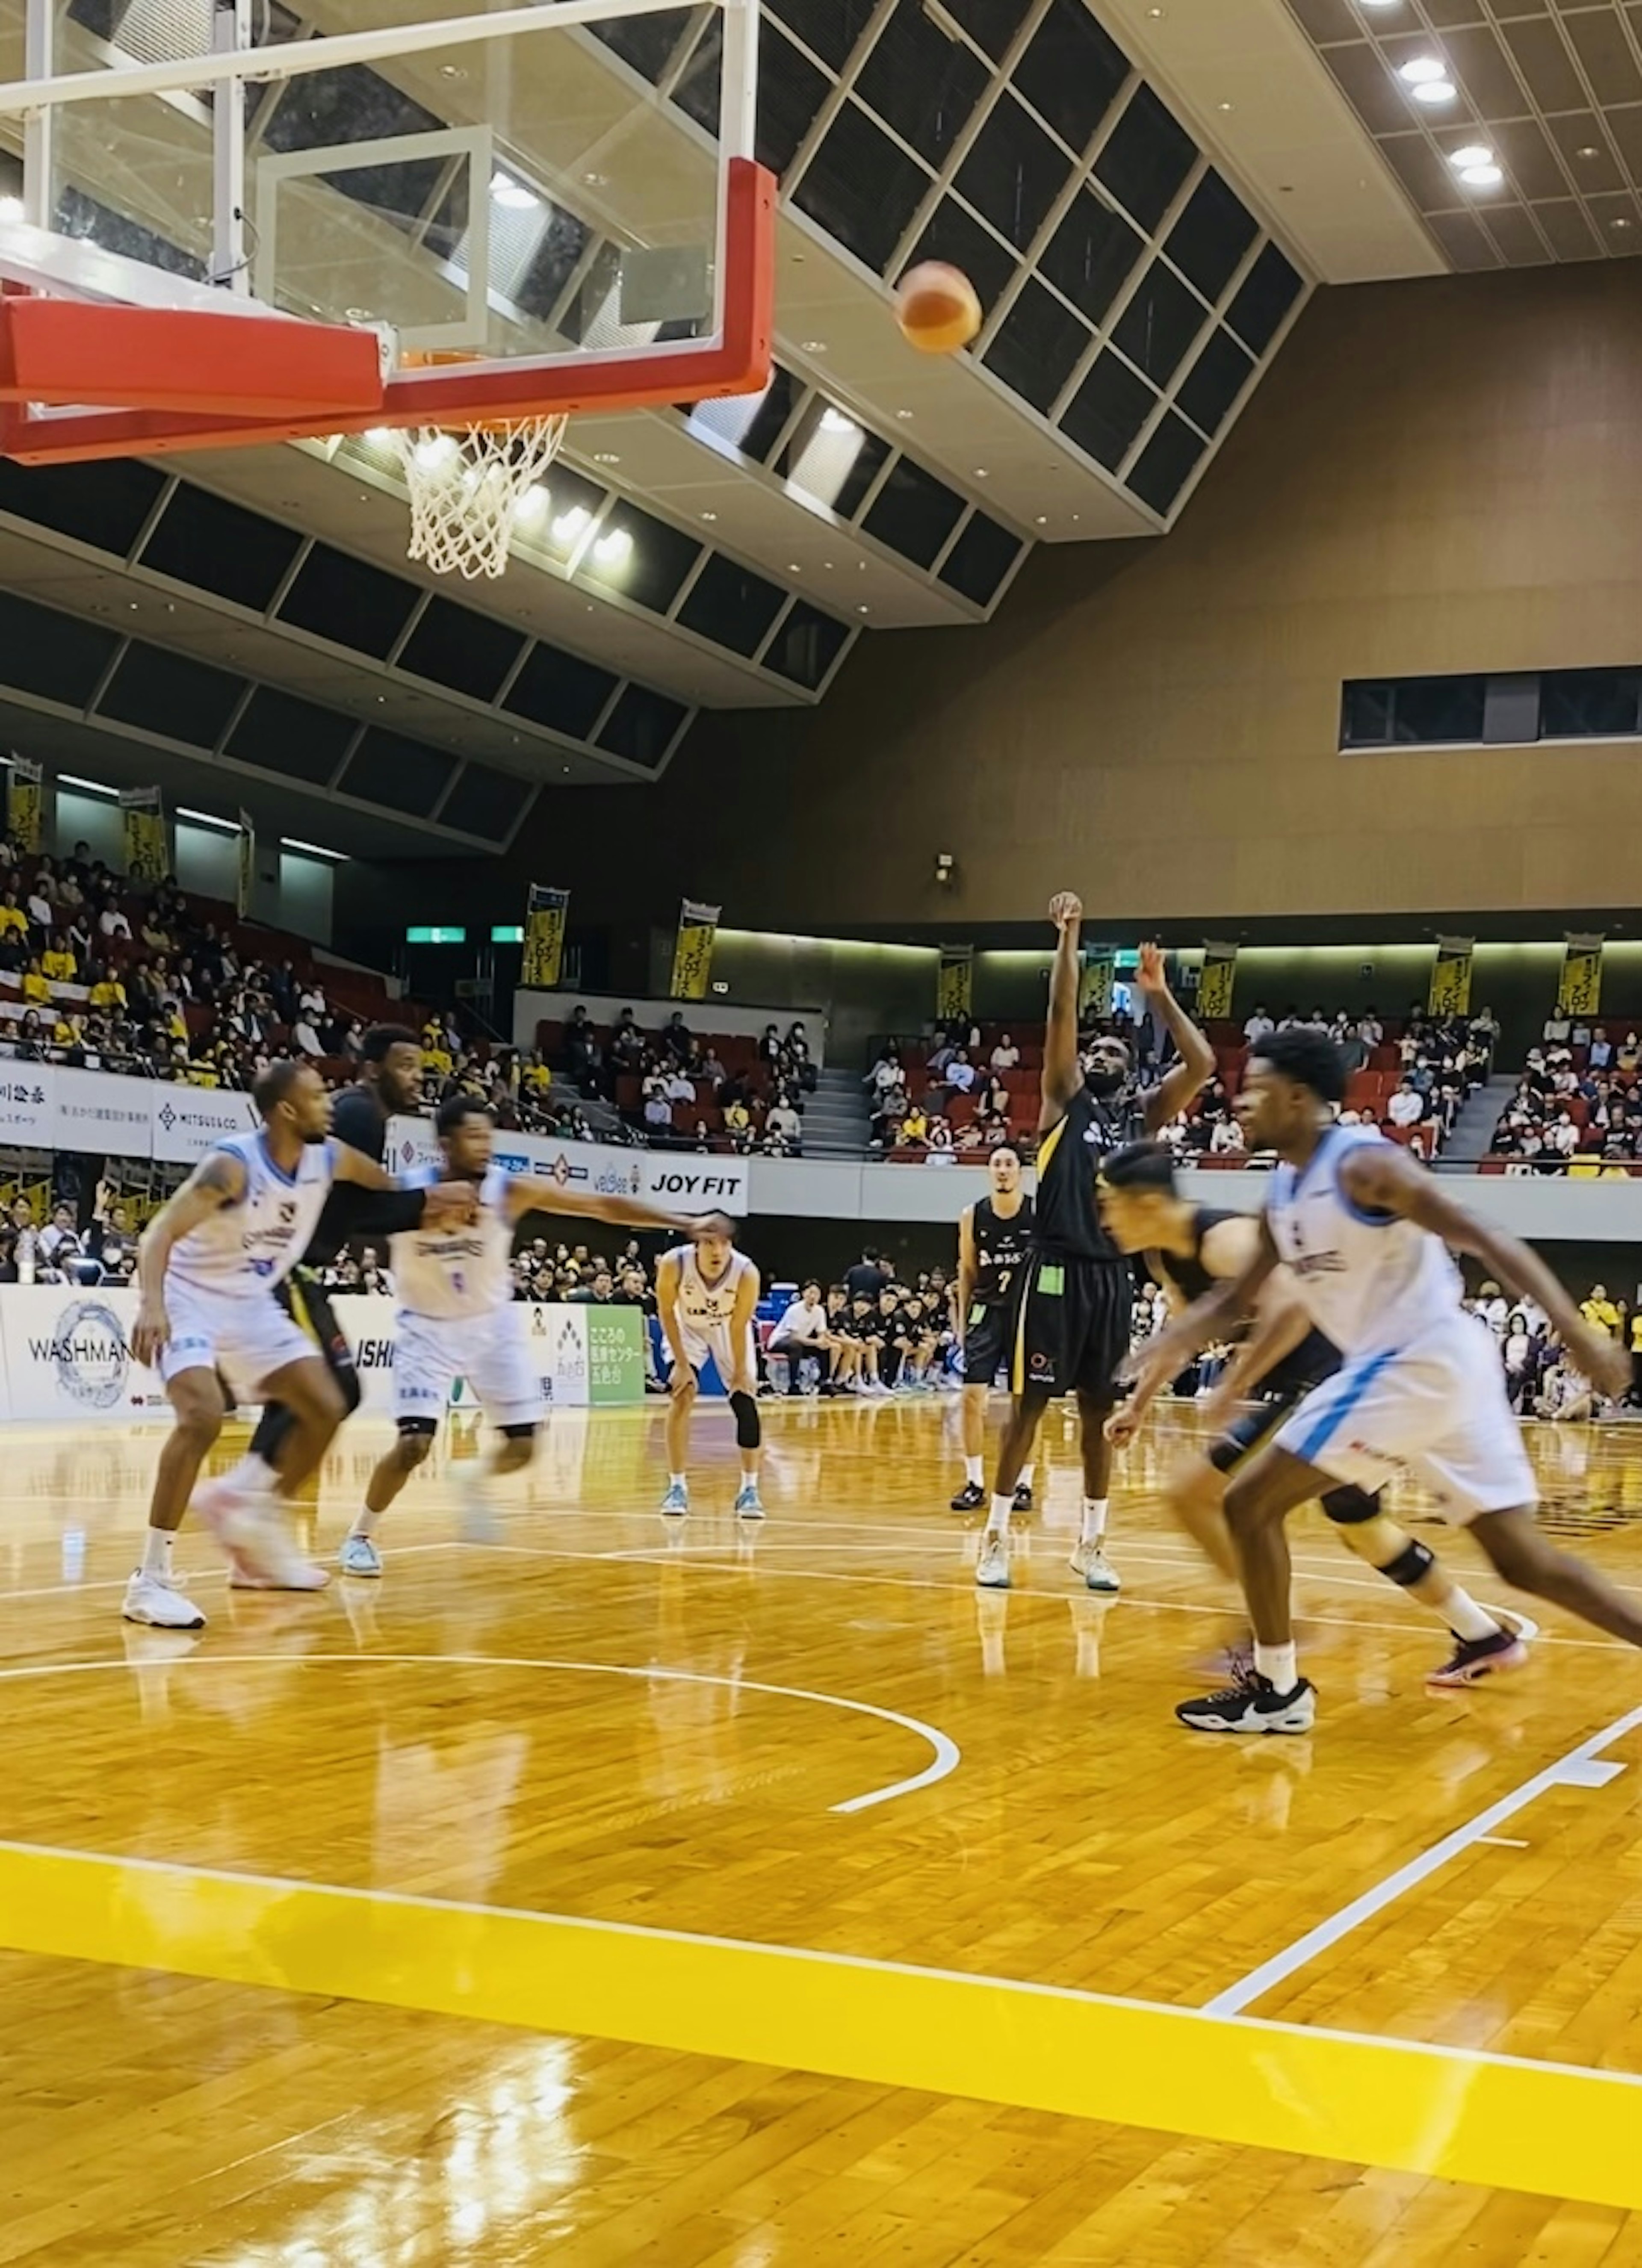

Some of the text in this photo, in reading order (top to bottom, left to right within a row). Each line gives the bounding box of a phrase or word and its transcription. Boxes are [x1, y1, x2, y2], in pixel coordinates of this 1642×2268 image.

[702, 1177, 741, 1195] FIT
[998, 1269, 1012, 1292] 7
[590, 1327, 626, 1345] こころの
[28, 1337, 136, 1363] WASHMAN
